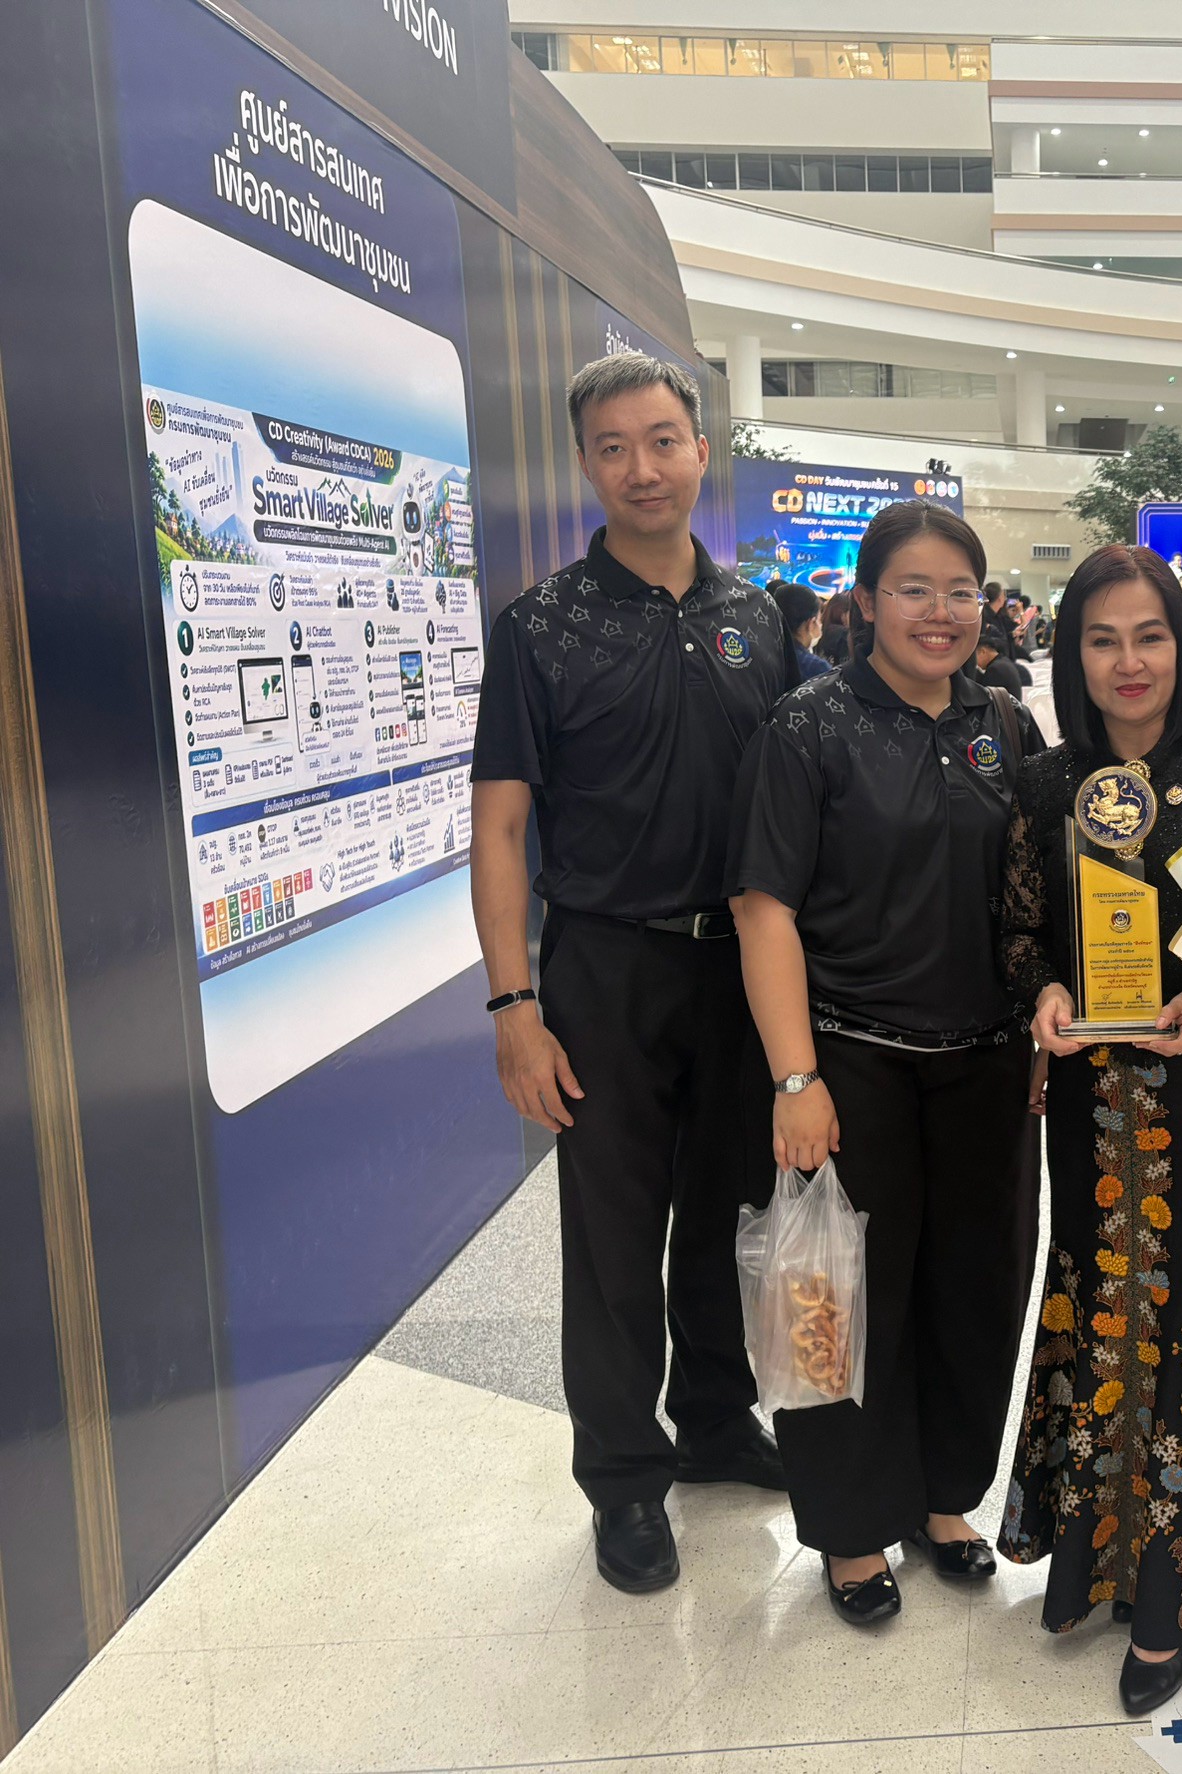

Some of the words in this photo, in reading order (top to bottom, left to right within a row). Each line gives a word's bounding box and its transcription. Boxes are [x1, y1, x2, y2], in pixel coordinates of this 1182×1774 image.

[382, 0, 458, 76] ISION
[240, 90, 385, 215] ศูนย์สารสนเทศ
[213, 132, 411, 294] เพื่อการพัฒนาชุมชน
[167, 416, 231, 446] กรมการพัฒนาชุมชน
[268, 421, 281, 440] CD
[283, 425, 323, 452] Creativity
[324, 436, 349, 457] (Award
[350, 443, 371, 462] CDCA)
[373, 447, 394, 468] 2026
[265, 466, 298, 485] นวัตกรรม
[795, 474, 808, 485] CD
[251, 475, 305, 519] Smart
[304, 488, 349, 529] Village
[349, 487, 395, 530] Solver
[772, 488, 804, 513] CD
[805, 491, 866, 515] NEXT
[211, 583, 219, 592] 30
[180, 629, 189, 647] 1
[196, 627, 205, 640] AI
[205, 627, 225, 640] Smart
[225, 627, 247, 640] Village
[247, 627, 266, 639] Solver
[292, 628, 299, 643] 2
[312, 626, 332, 637] Chatbot
[366, 626, 372, 640] 3
[1092, 889, 1146, 898] กระทรวงมหาดไทย
